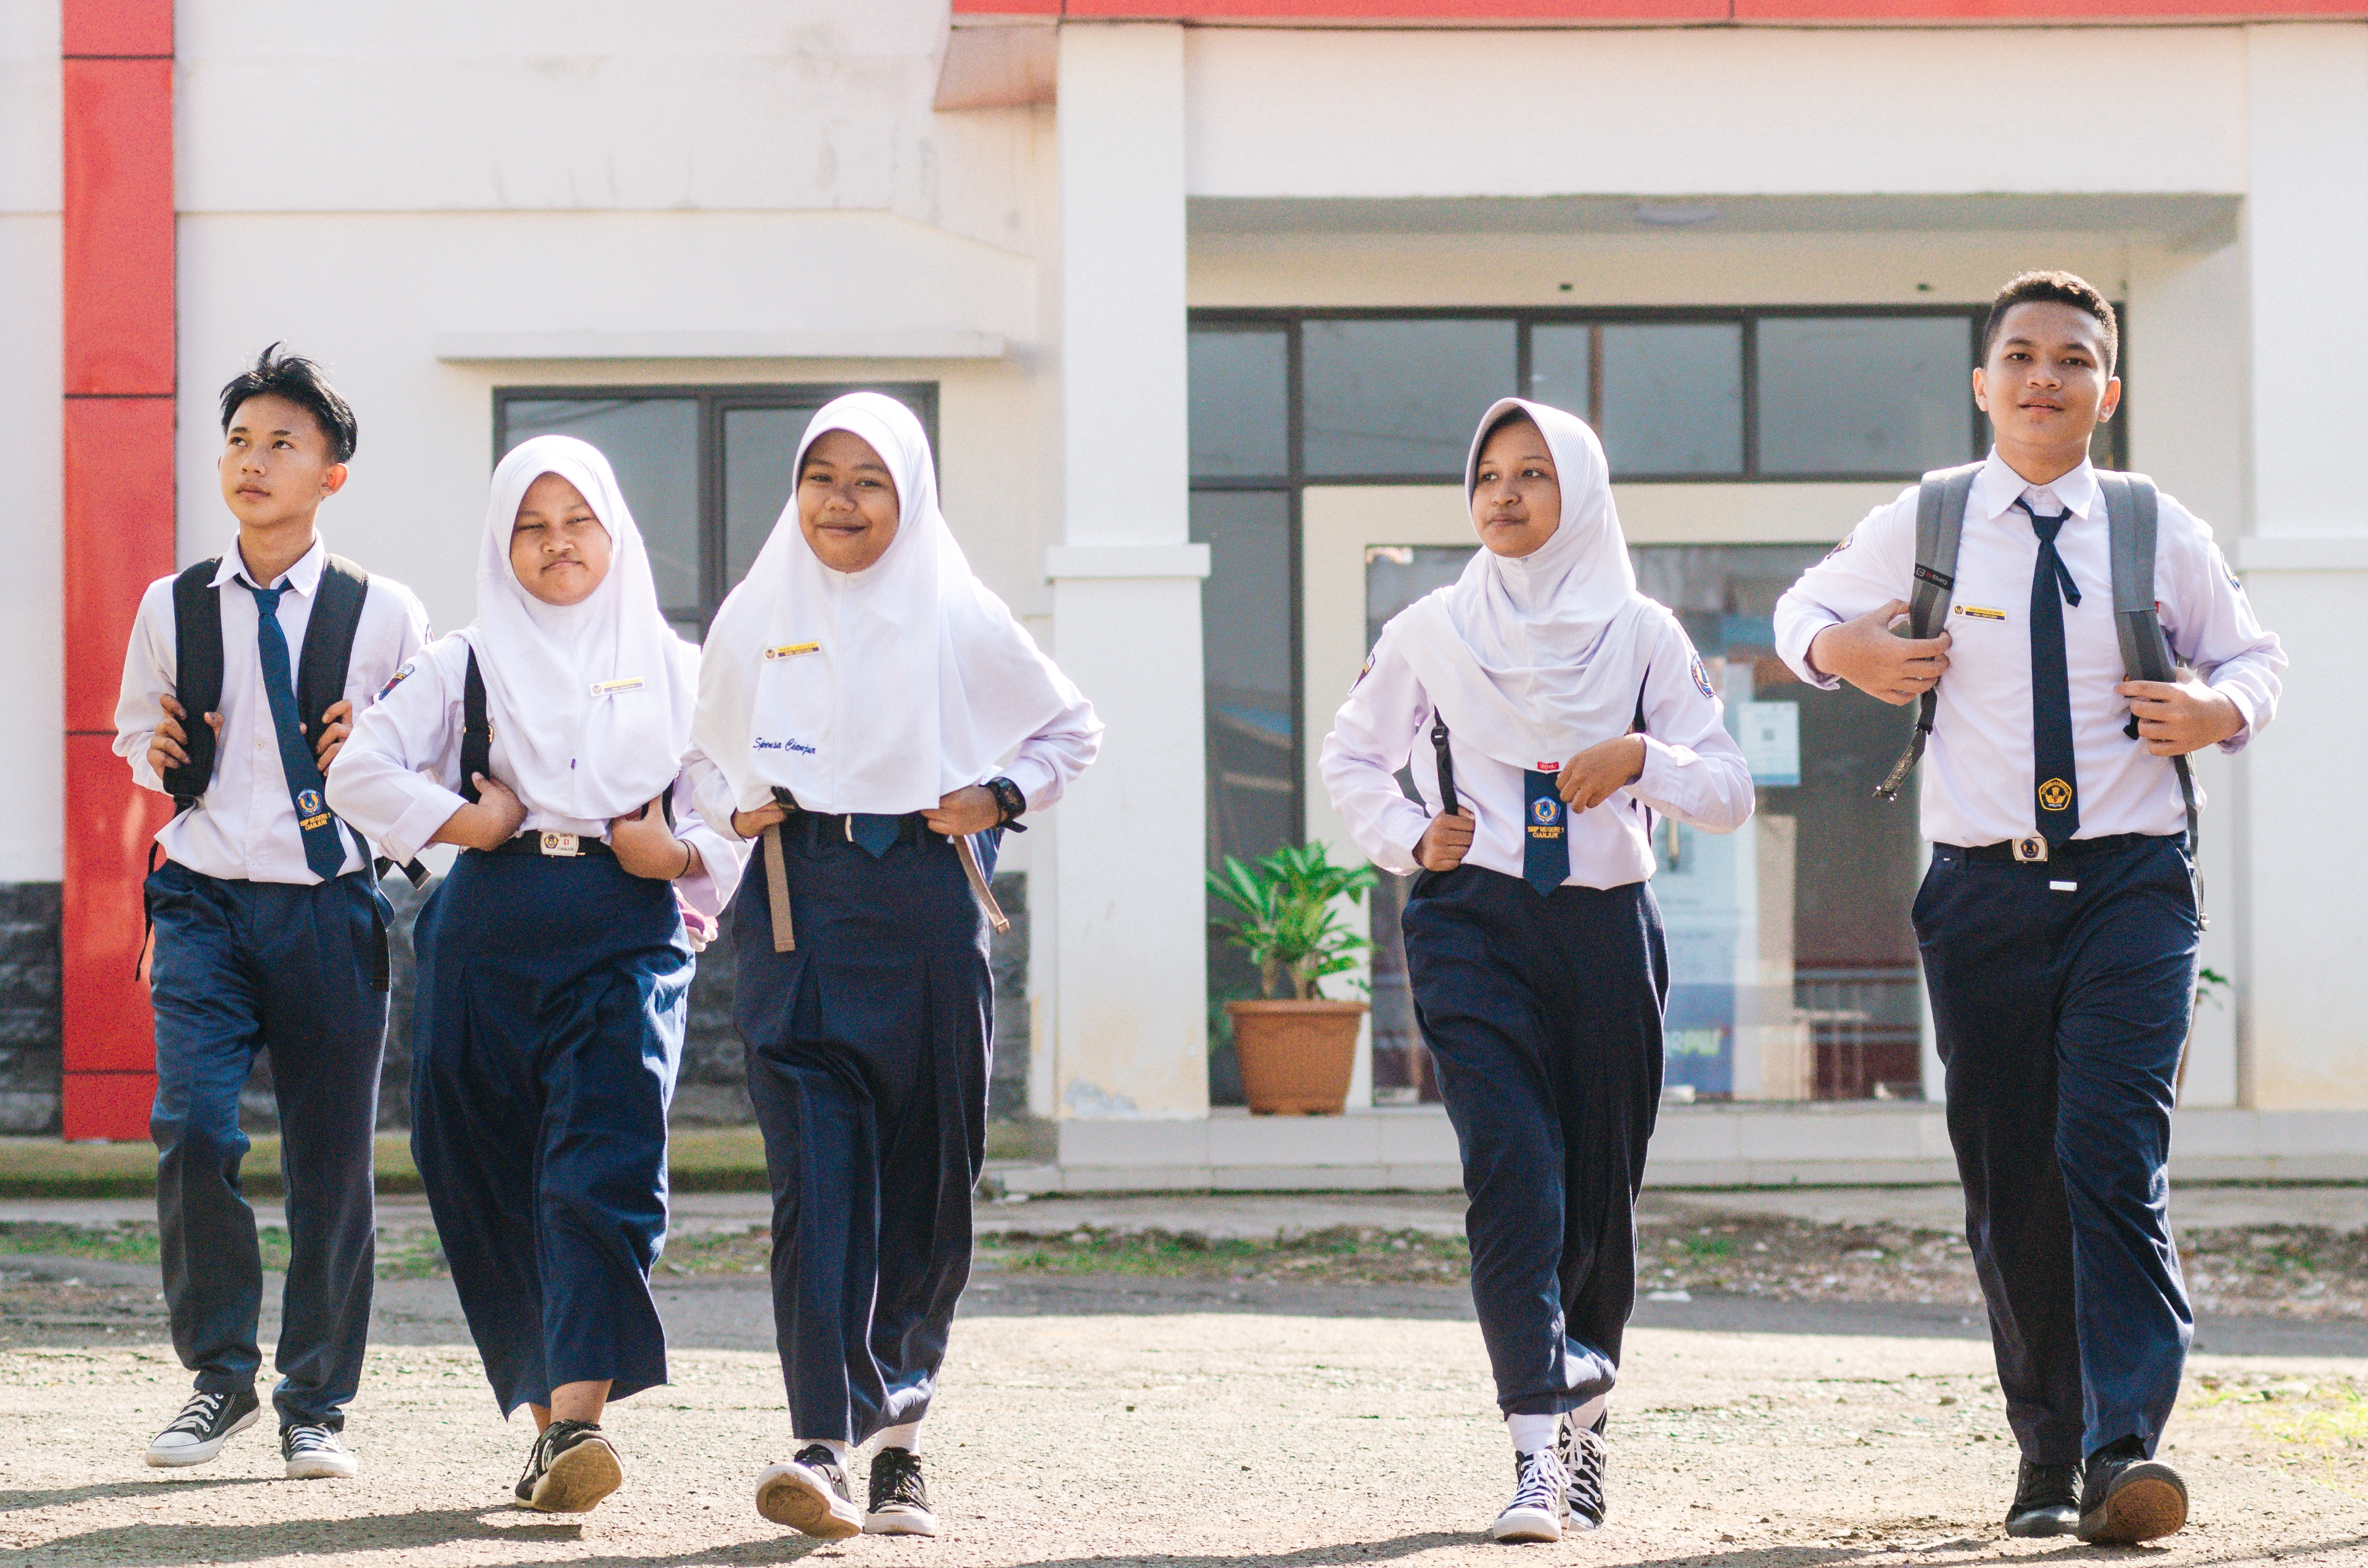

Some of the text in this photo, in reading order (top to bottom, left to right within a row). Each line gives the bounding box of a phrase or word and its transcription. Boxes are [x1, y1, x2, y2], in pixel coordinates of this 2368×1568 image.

[753, 737, 781, 751] Spensa
[309, 813, 327, 824] NEGERI
[305, 819, 327, 831] CIANJUR
